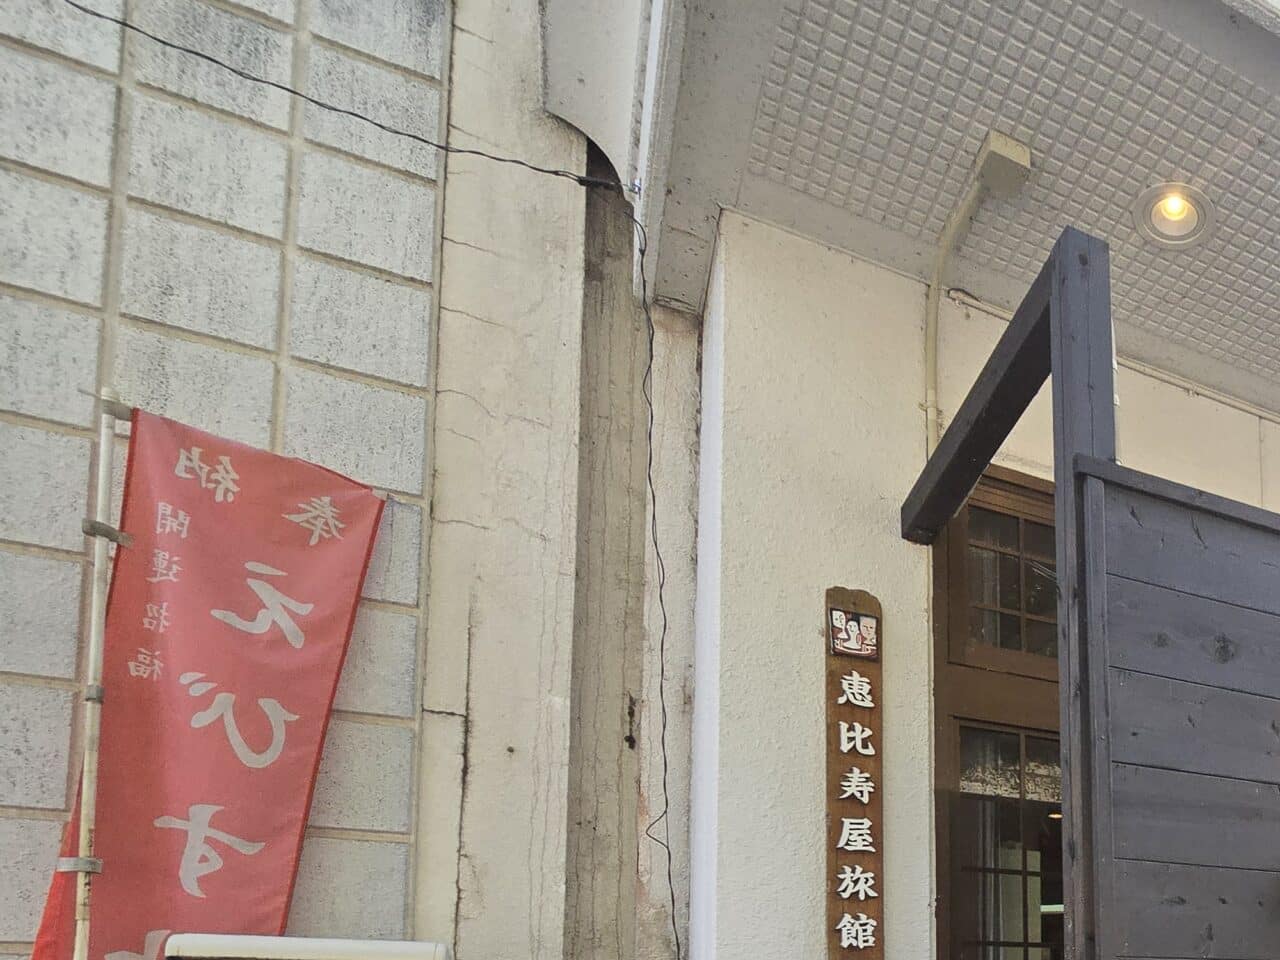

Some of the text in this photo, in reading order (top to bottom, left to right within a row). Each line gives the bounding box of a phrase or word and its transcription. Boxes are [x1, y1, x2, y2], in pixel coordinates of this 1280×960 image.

[836, 670, 879, 949] 恵比寿屋旅館
